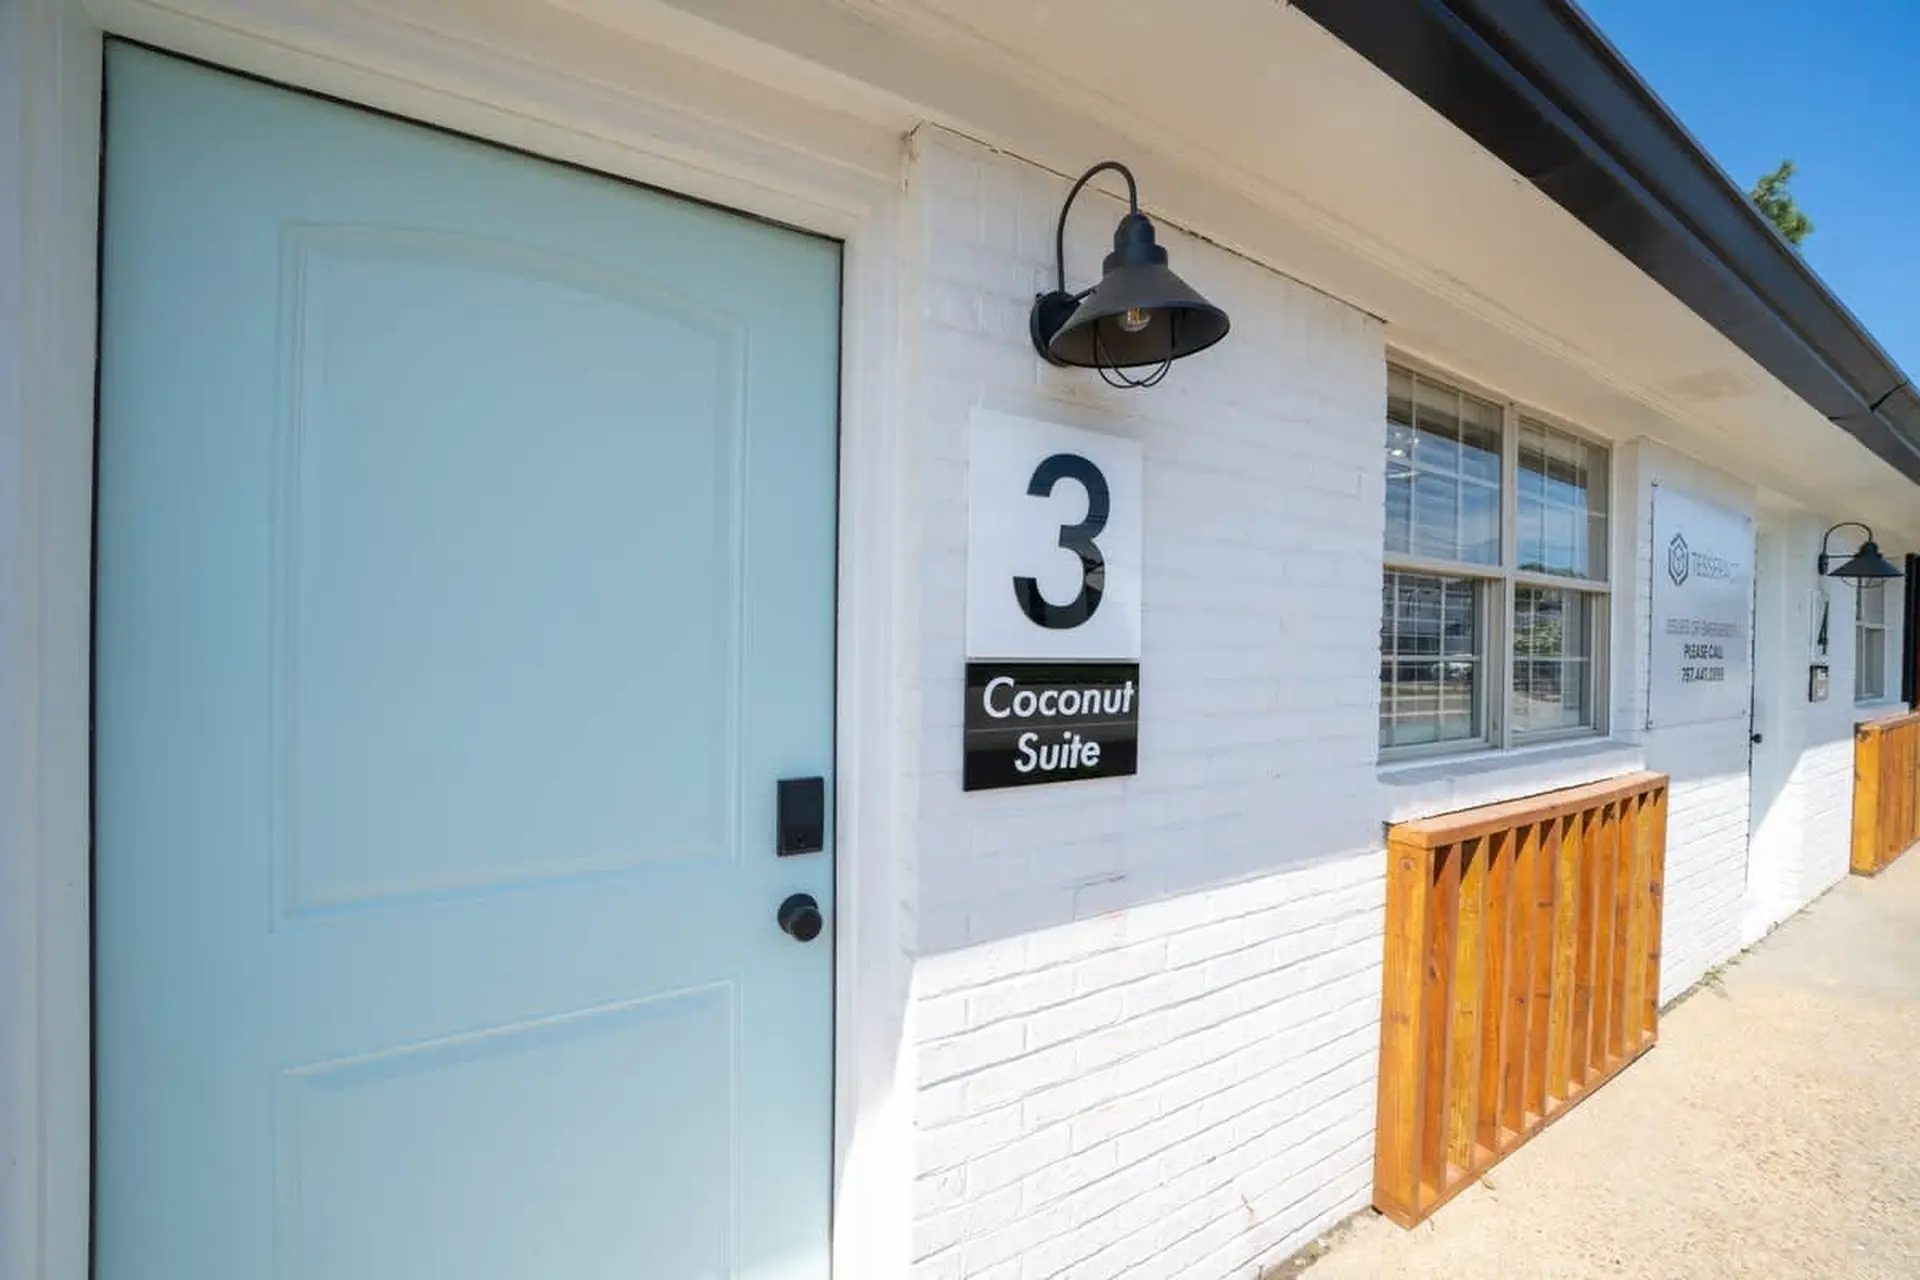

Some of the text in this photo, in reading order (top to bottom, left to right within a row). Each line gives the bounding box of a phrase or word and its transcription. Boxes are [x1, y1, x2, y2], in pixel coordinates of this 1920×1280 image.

[1013, 453, 1110, 629] 3
[1684, 643, 1724, 660] PLEASE CALL
[983, 677, 1134, 718] Coconut
[1014, 730, 1101, 773] Suite
